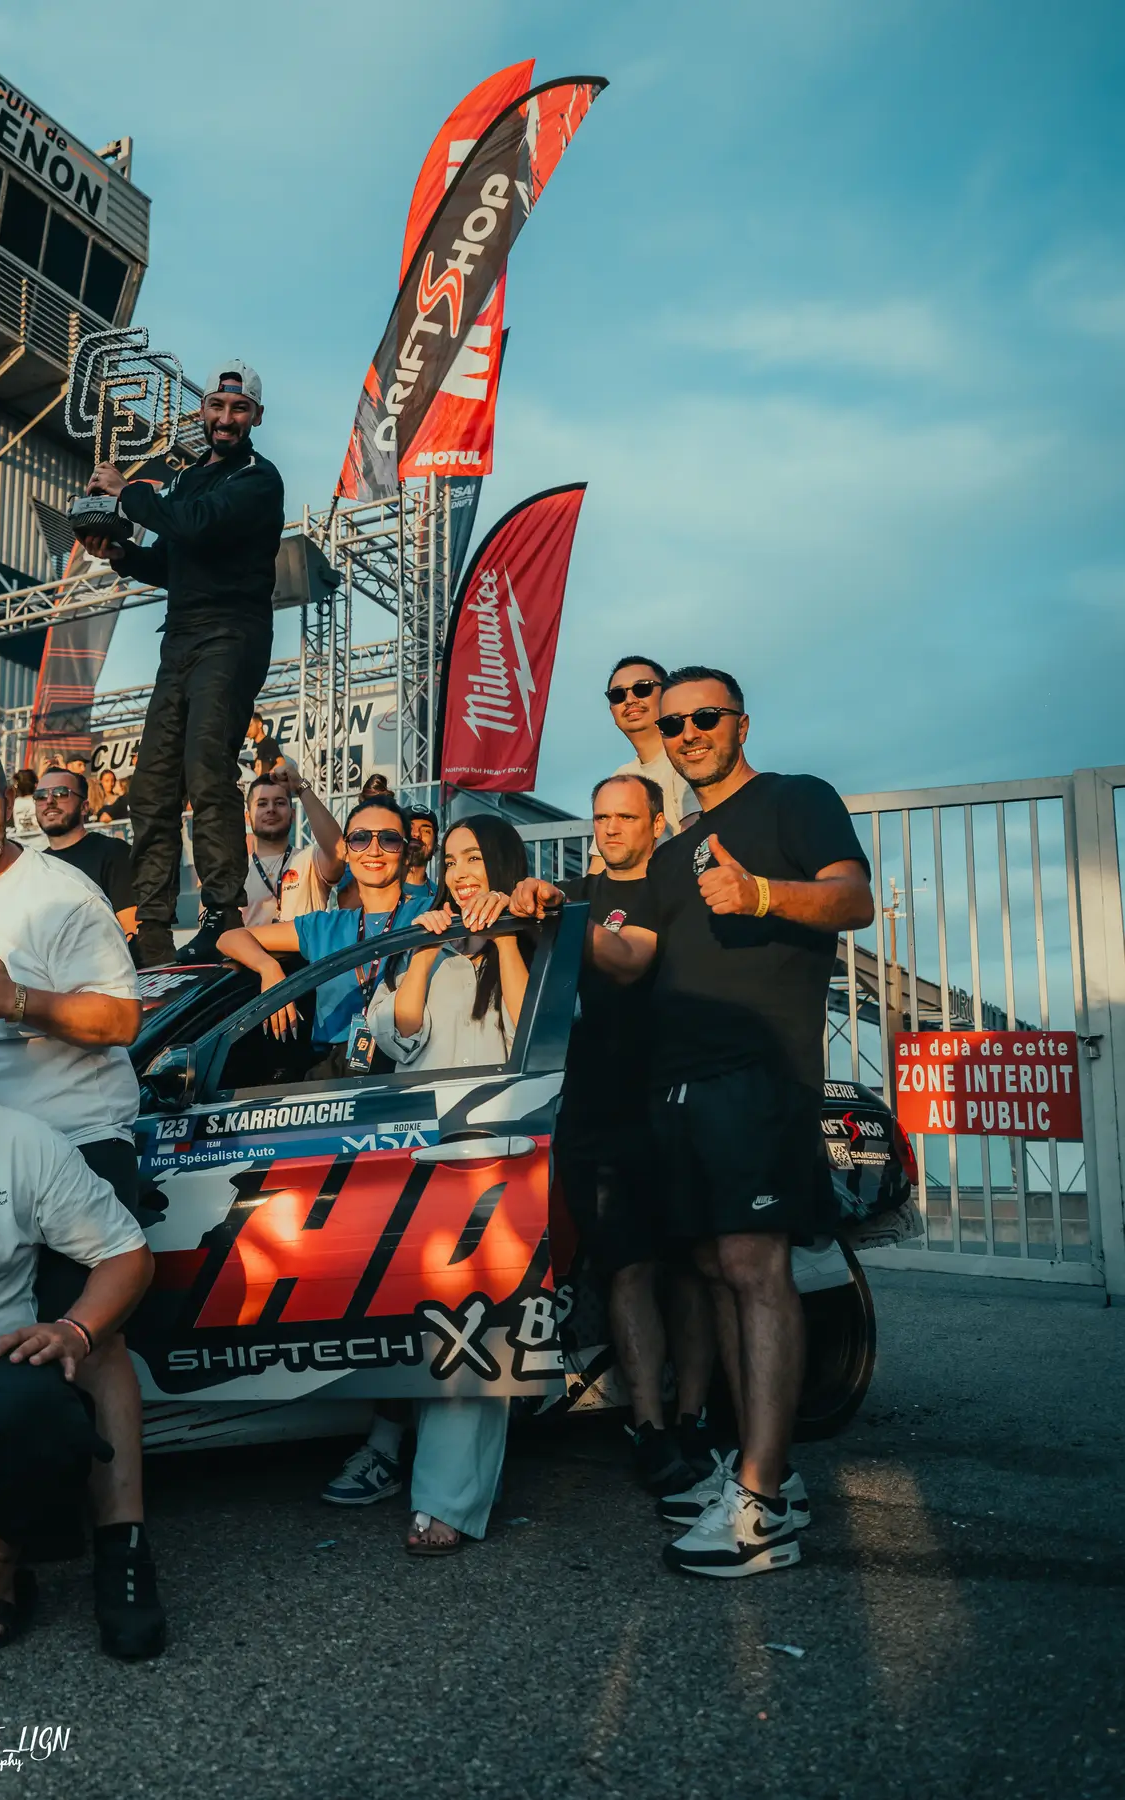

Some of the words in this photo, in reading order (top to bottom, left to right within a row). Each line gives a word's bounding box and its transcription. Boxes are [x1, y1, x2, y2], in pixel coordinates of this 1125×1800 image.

[45, 126, 68, 151] de
[375, 173, 510, 452] DRIFTSHOP
[414, 450, 482, 468] MOTUL
[462, 567, 519, 741] Milwaukee
[899, 1042, 921, 1057] au
[929, 1038, 971, 1057] delà
[980, 1039, 1003, 1056] de
[1012, 1039, 1069, 1056] cette
[824, 1082, 859, 1099] SERIE
[898, 1064, 956, 1093] ZONE
[965, 1064, 1073, 1094] INTERDIT
[155, 1118, 189, 1140] 123
[206, 1101, 356, 1134] S.KARROUACHE
[393, 1122, 422, 1132] ROOKIE
[928, 1100, 956, 1129] AU
[966, 1101, 1051, 1132] PUBLIC
[150, 1157, 176, 1167] Mon
[179, 1149, 244, 1165] Spécialiste
[247, 1147, 276, 1158] Auto
[206, 1141, 221, 1149] TEAM
[169, 1335, 415, 1371] SHIFTECH
